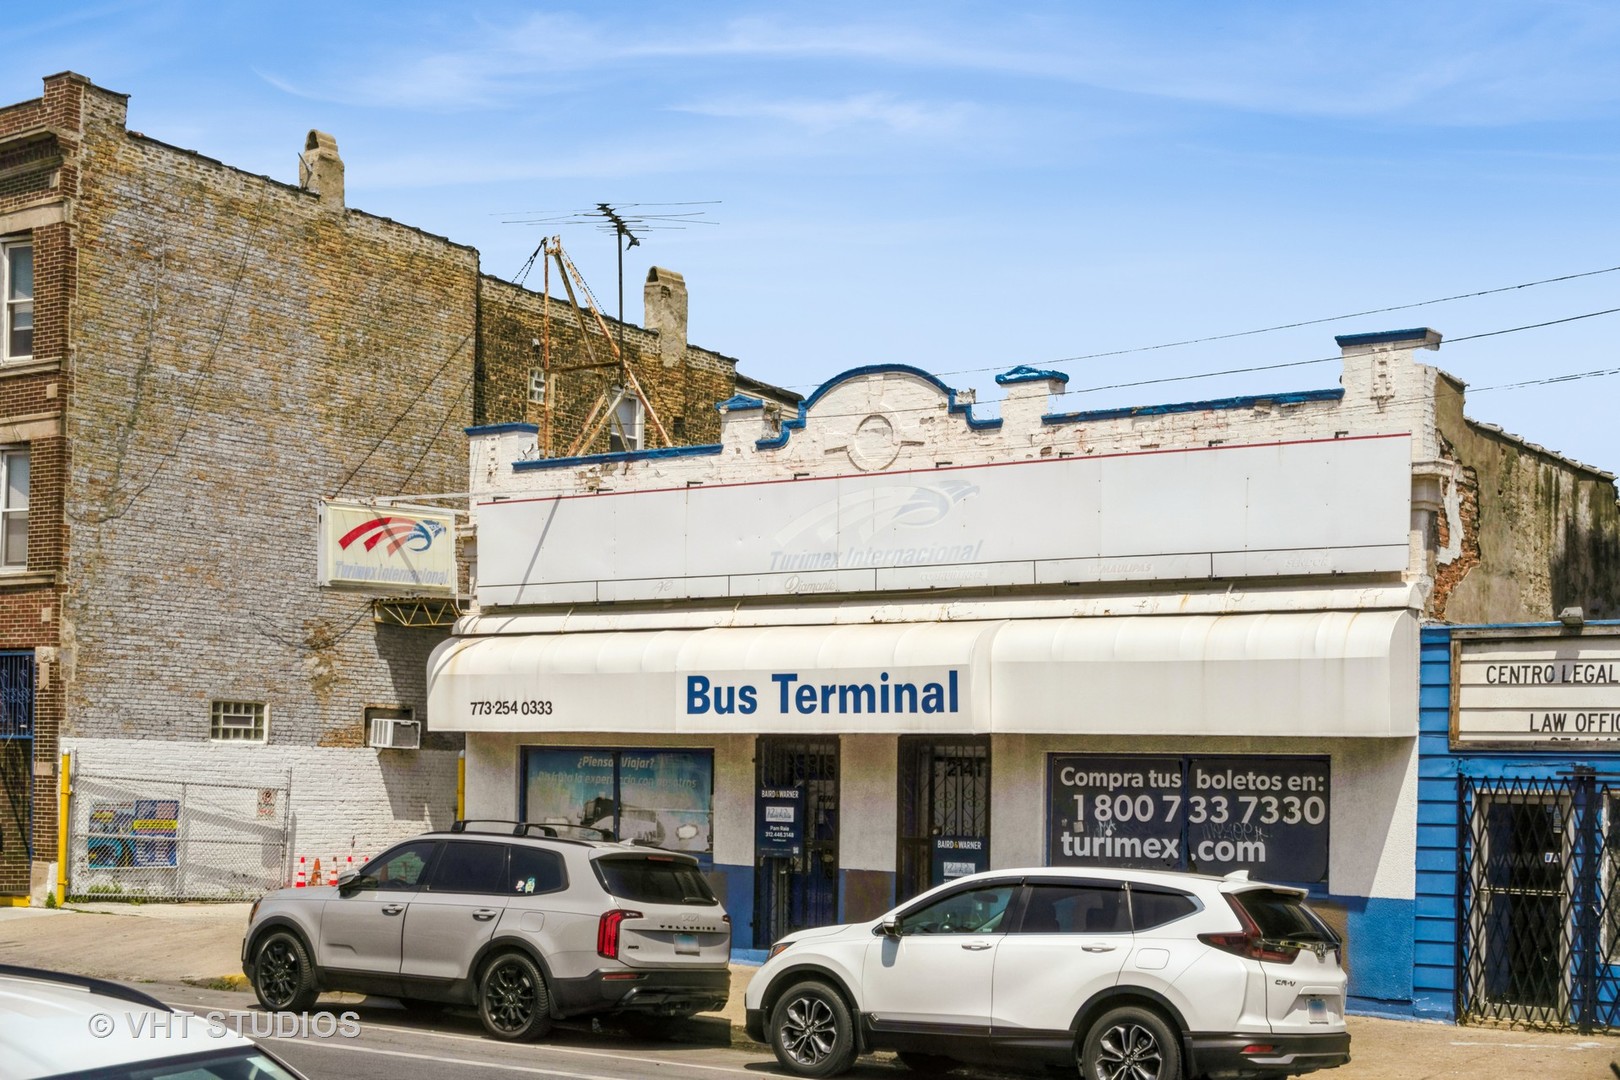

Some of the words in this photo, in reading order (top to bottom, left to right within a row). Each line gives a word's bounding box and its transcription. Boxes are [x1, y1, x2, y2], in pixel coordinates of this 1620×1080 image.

[770, 549, 843, 571] Turimex
[846, 540, 984, 567] Internacional
[335, 560, 378, 579] Turimex
[1486, 665, 1555, 684] CENTRO
[1562, 664, 1619, 683] LEGAL
[686, 675, 758, 715] Bus
[771, 670, 959, 714] Terminal
[521, 700, 553, 715] 0333
[1529, 713, 1567, 732] LAW
[1060, 766, 1144, 791] Compra
[1149, 770, 1182, 788] tus
[1196, 769, 1282, 791] boletos
[1287, 775, 1325, 791] en:
[1073, 794, 1084, 821] 1
[1094, 795, 1154, 822] 800
[1238, 796, 1326, 825] 7330
